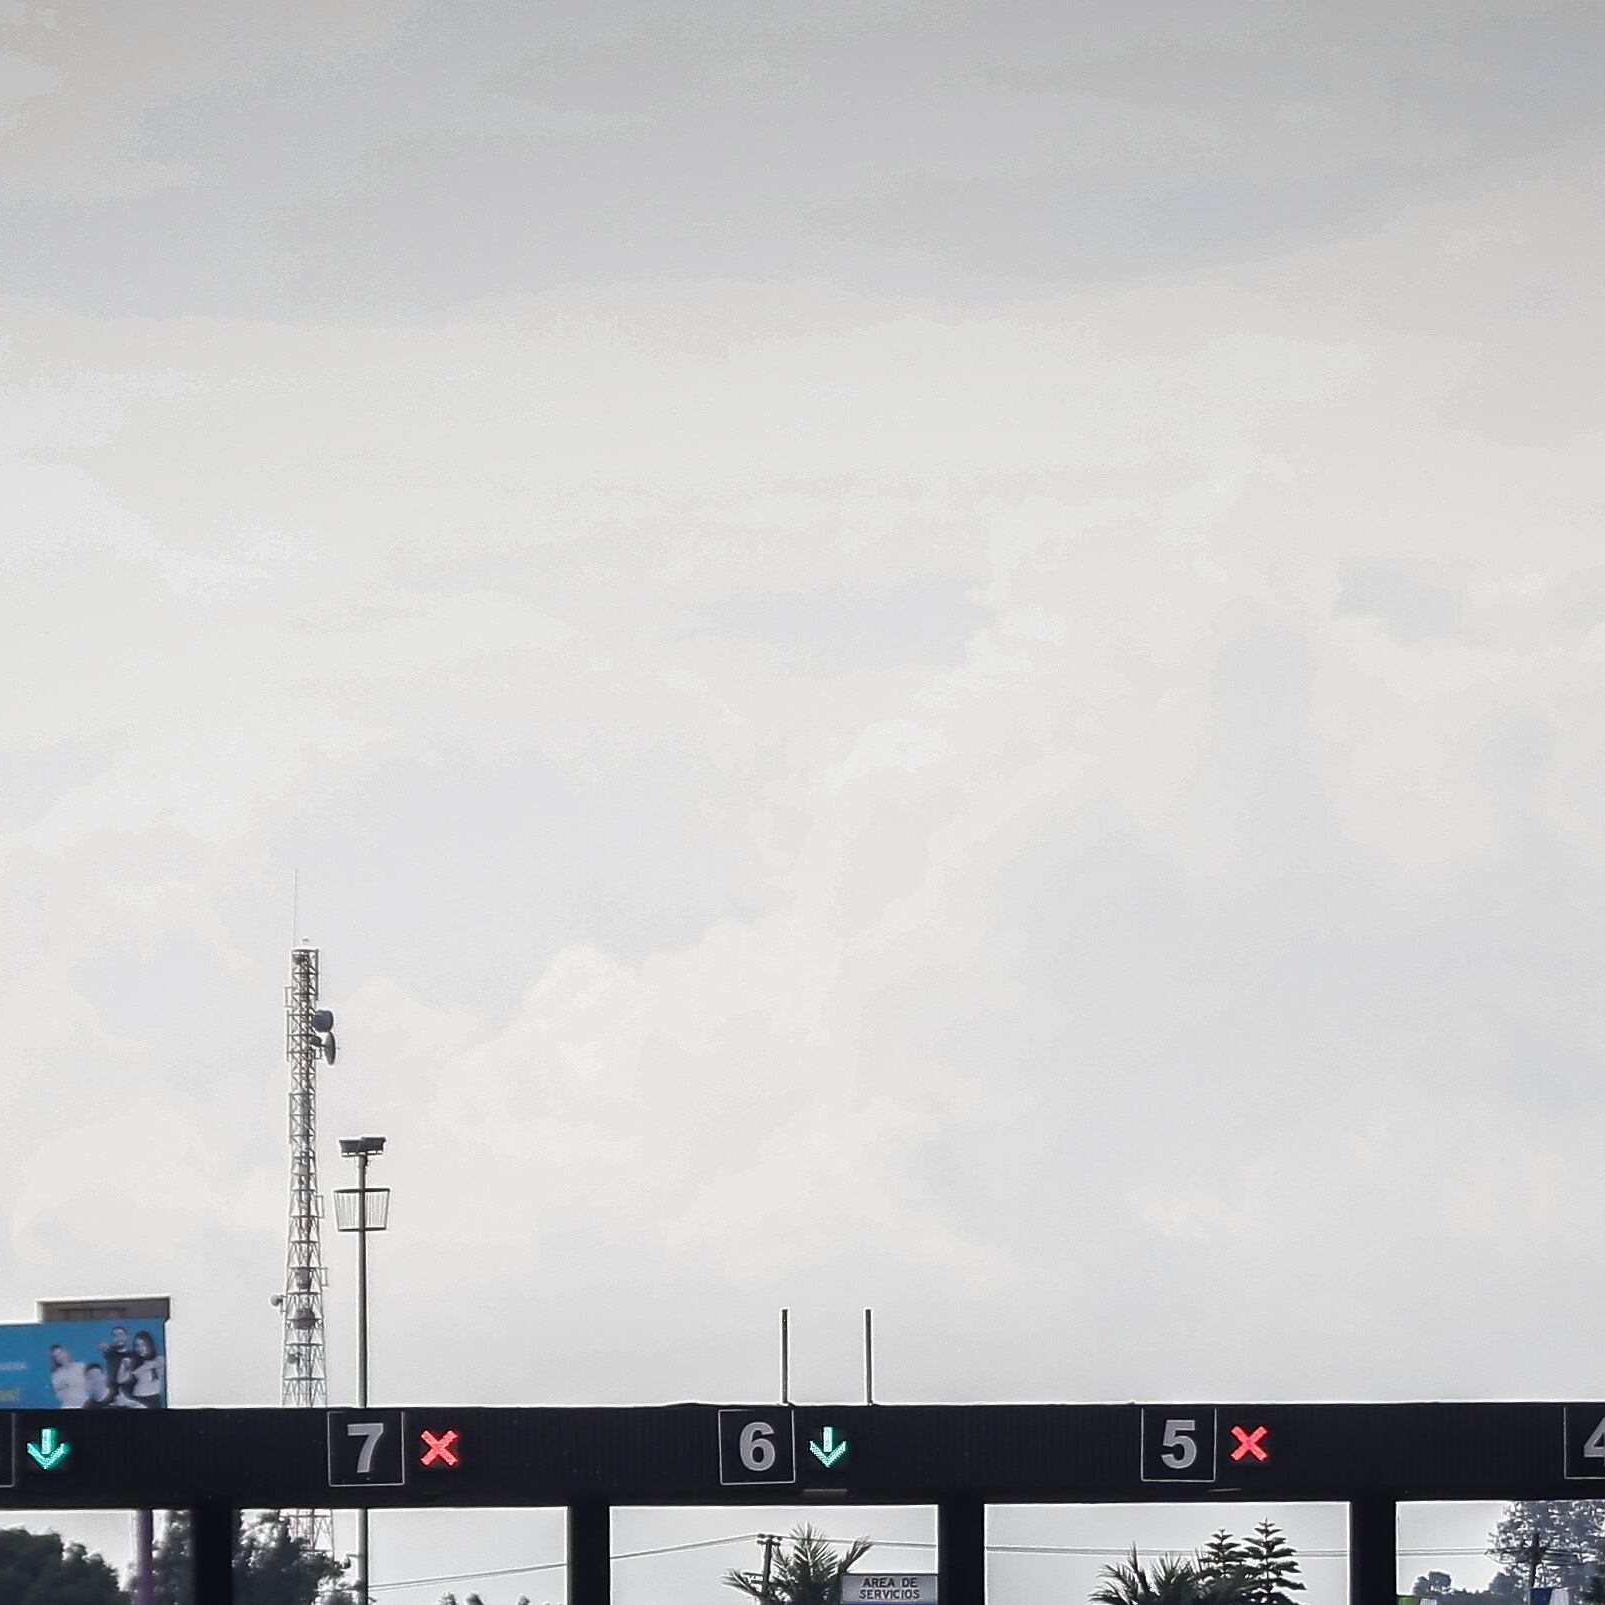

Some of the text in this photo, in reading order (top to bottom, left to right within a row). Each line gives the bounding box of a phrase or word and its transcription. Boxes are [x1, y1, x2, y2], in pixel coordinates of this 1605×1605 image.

[347, 1422, 384, 1474] 7
[739, 1421, 775, 1472] 6
[1161, 1419, 1197, 1470] 5
[859, 1589, 920, 1600] SERVICIOS
[862, 1578, 918, 1588] AREA DE
